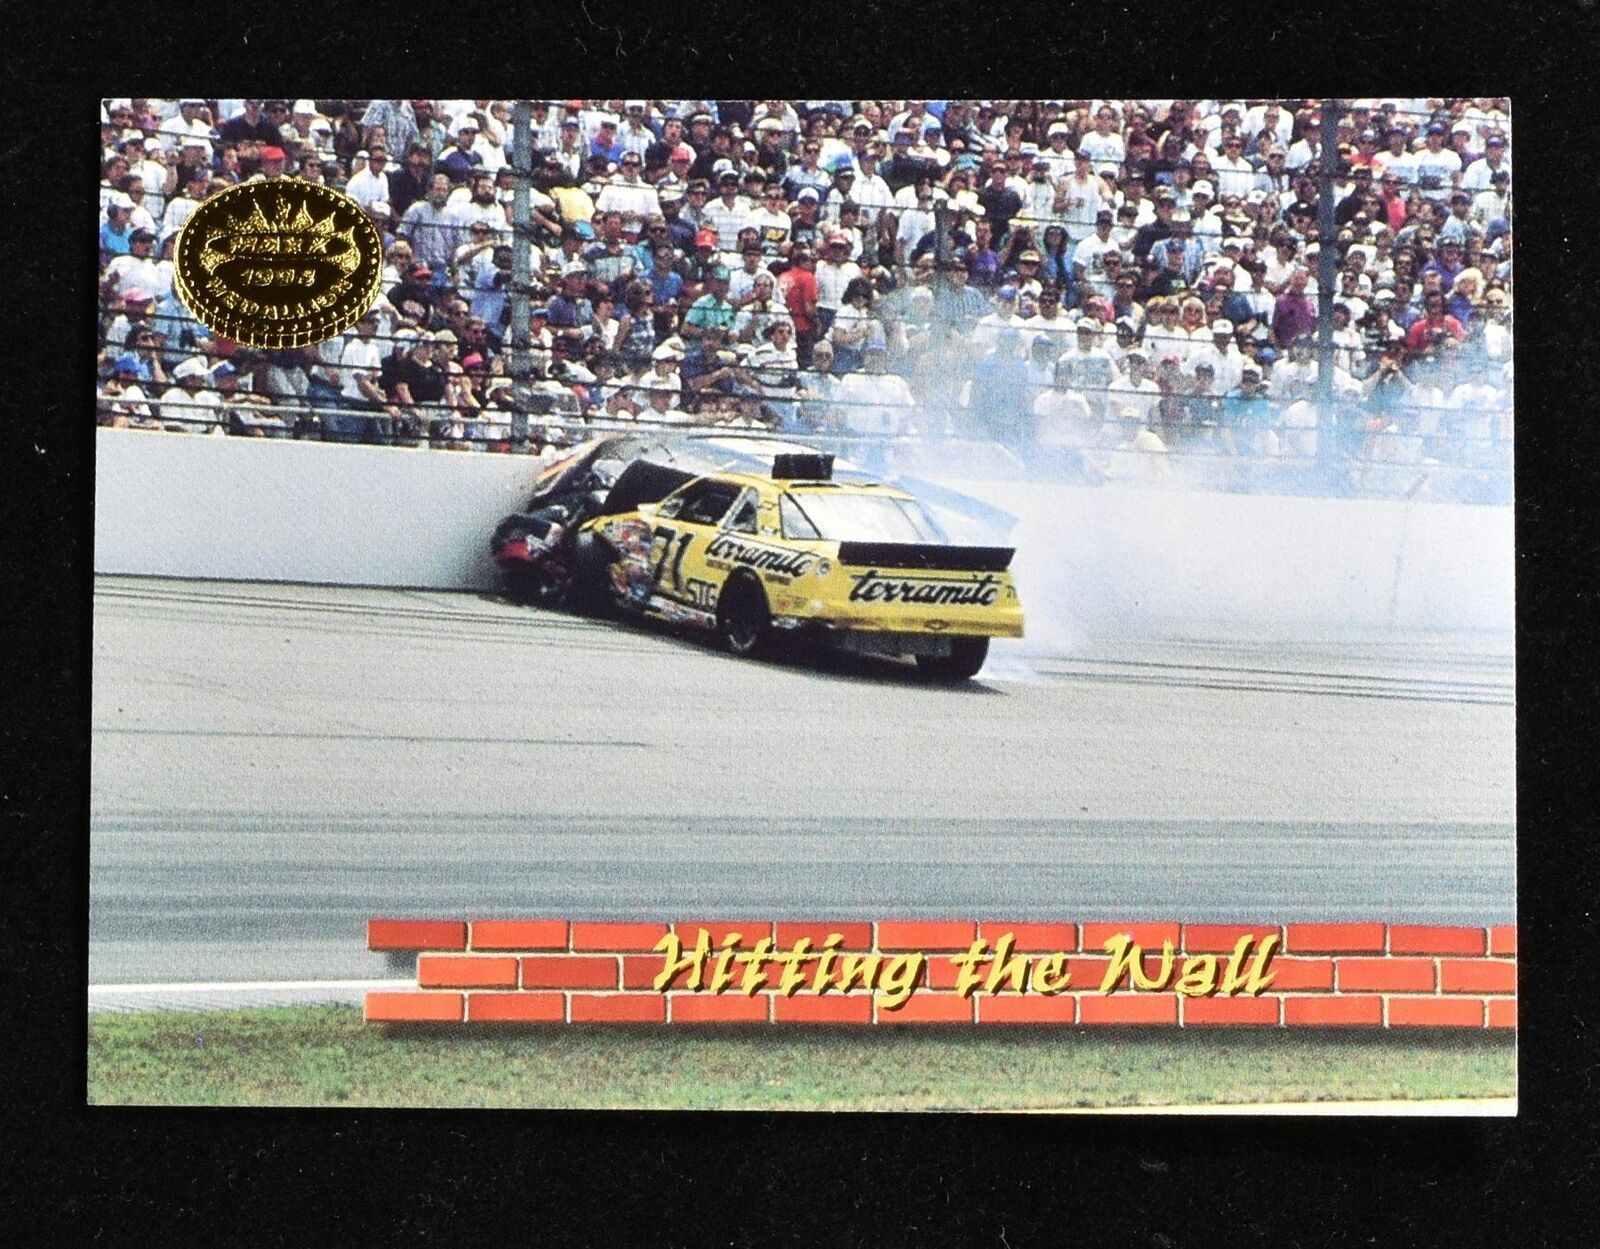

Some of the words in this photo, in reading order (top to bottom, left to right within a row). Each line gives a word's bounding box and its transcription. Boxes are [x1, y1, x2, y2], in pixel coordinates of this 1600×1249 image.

[230, 236, 331, 254] MAXX
[653, 525, 695, 591] 71
[848, 569, 1002, 606] terramite
[653, 928, 925, 1010] Hitting
[951, 931, 1071, 999] the
[1099, 931, 1278, 998] Wall
